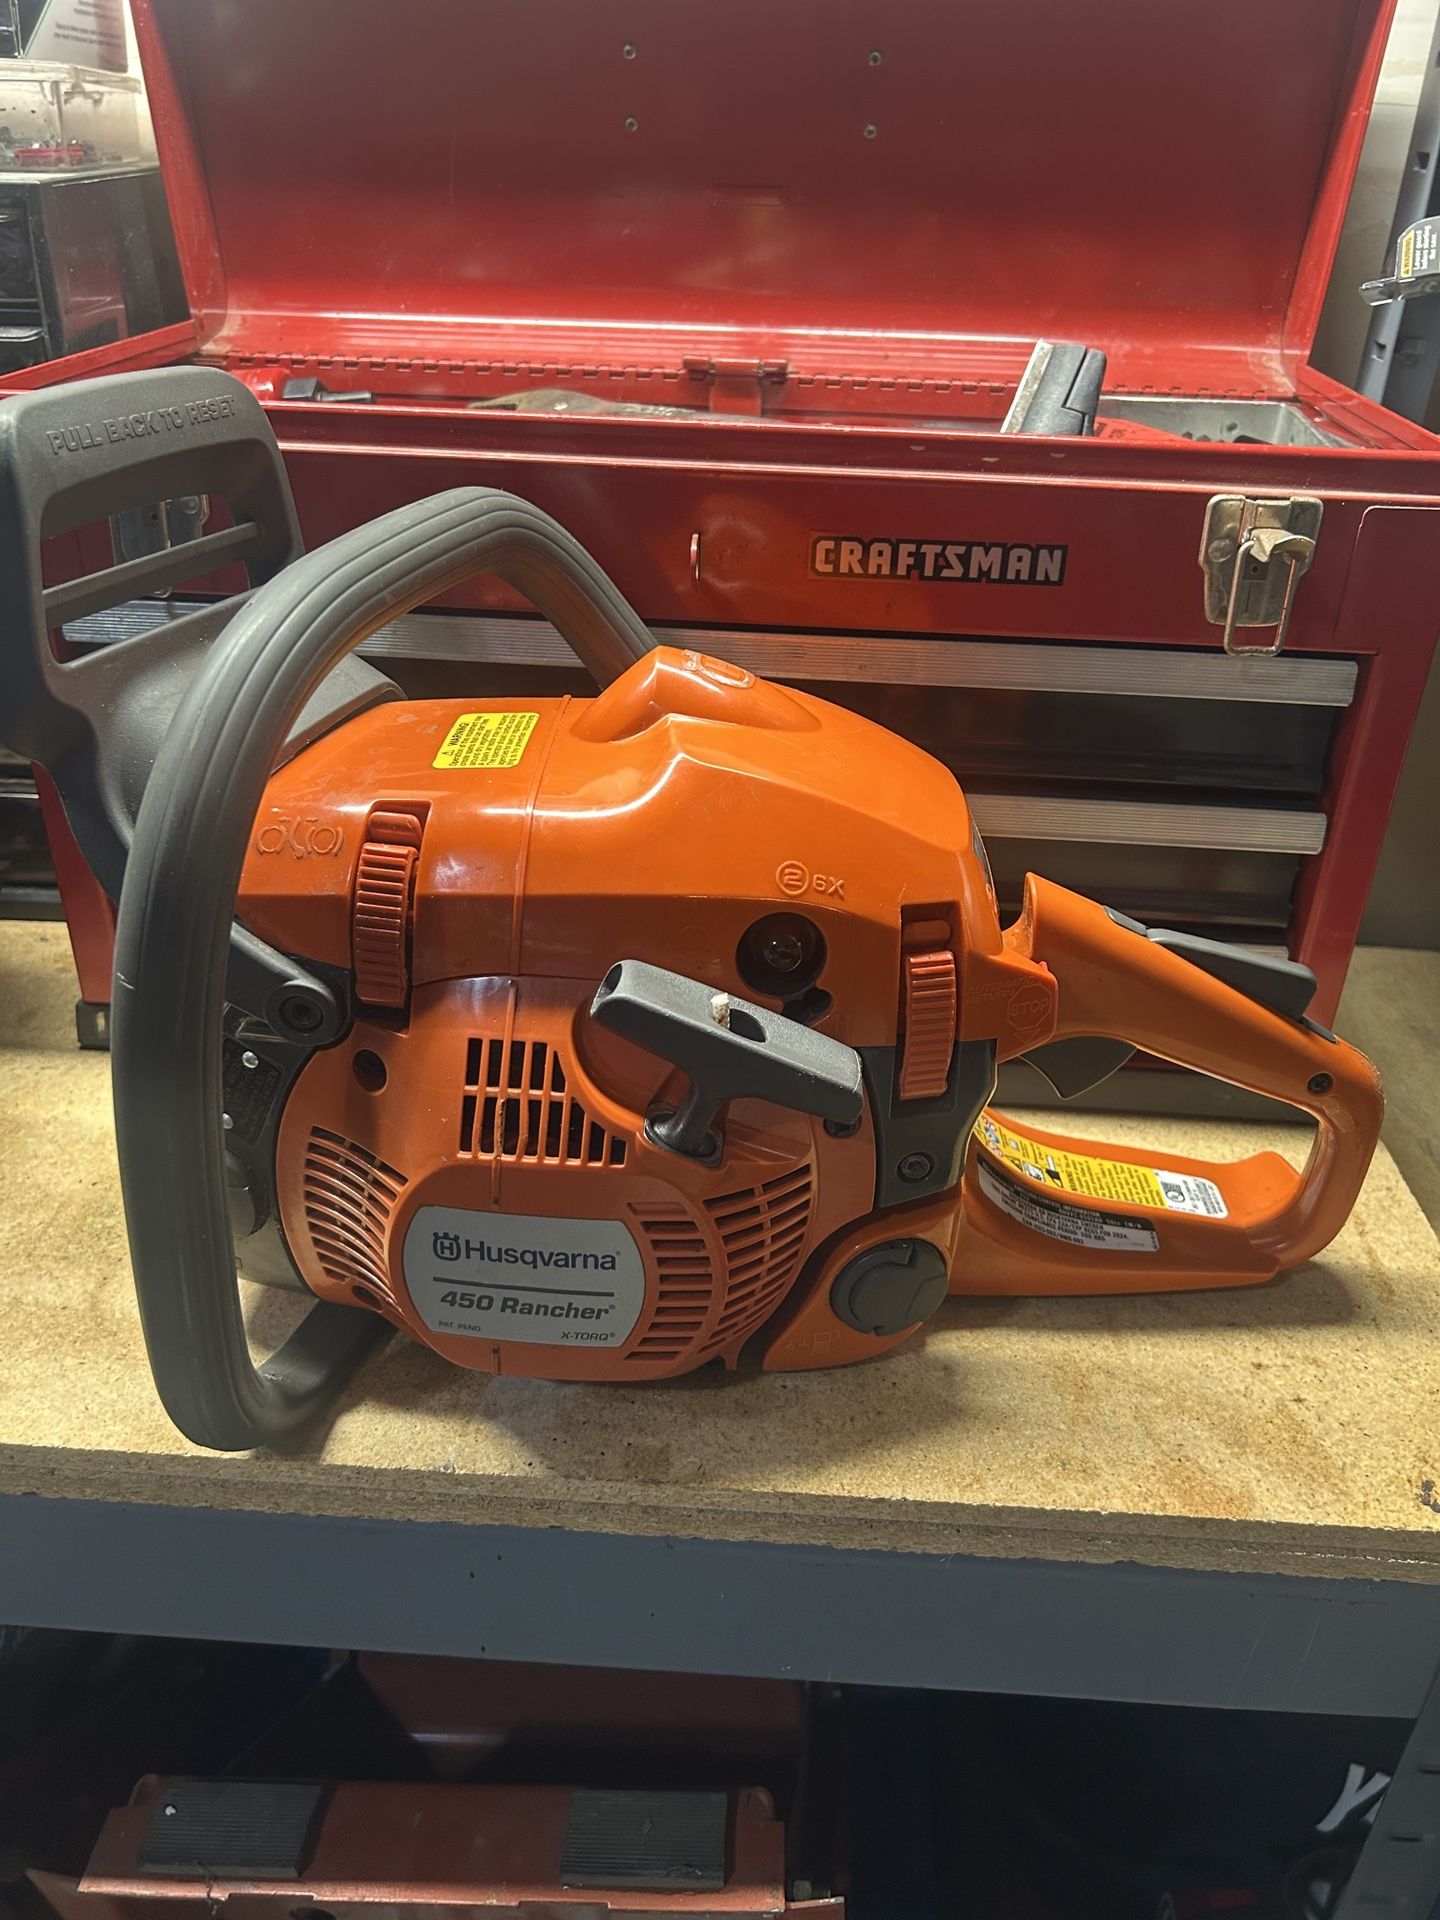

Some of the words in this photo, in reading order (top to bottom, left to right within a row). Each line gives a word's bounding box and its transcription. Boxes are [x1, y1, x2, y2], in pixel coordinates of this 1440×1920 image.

[46, 424, 102, 455] PULL
[104, 411, 160, 443] BACK
[158, 407, 184, 431] TO
[184, 395, 236, 425] RESET
[815, 540, 1063, 582] CRAFTSMAN
[813, 874, 845, 900] 6X
[1009, 998, 1050, 1018] STOP
[464, 1238, 616, 1271] Husqvarna
[440, 1290, 494, 1312] 450
